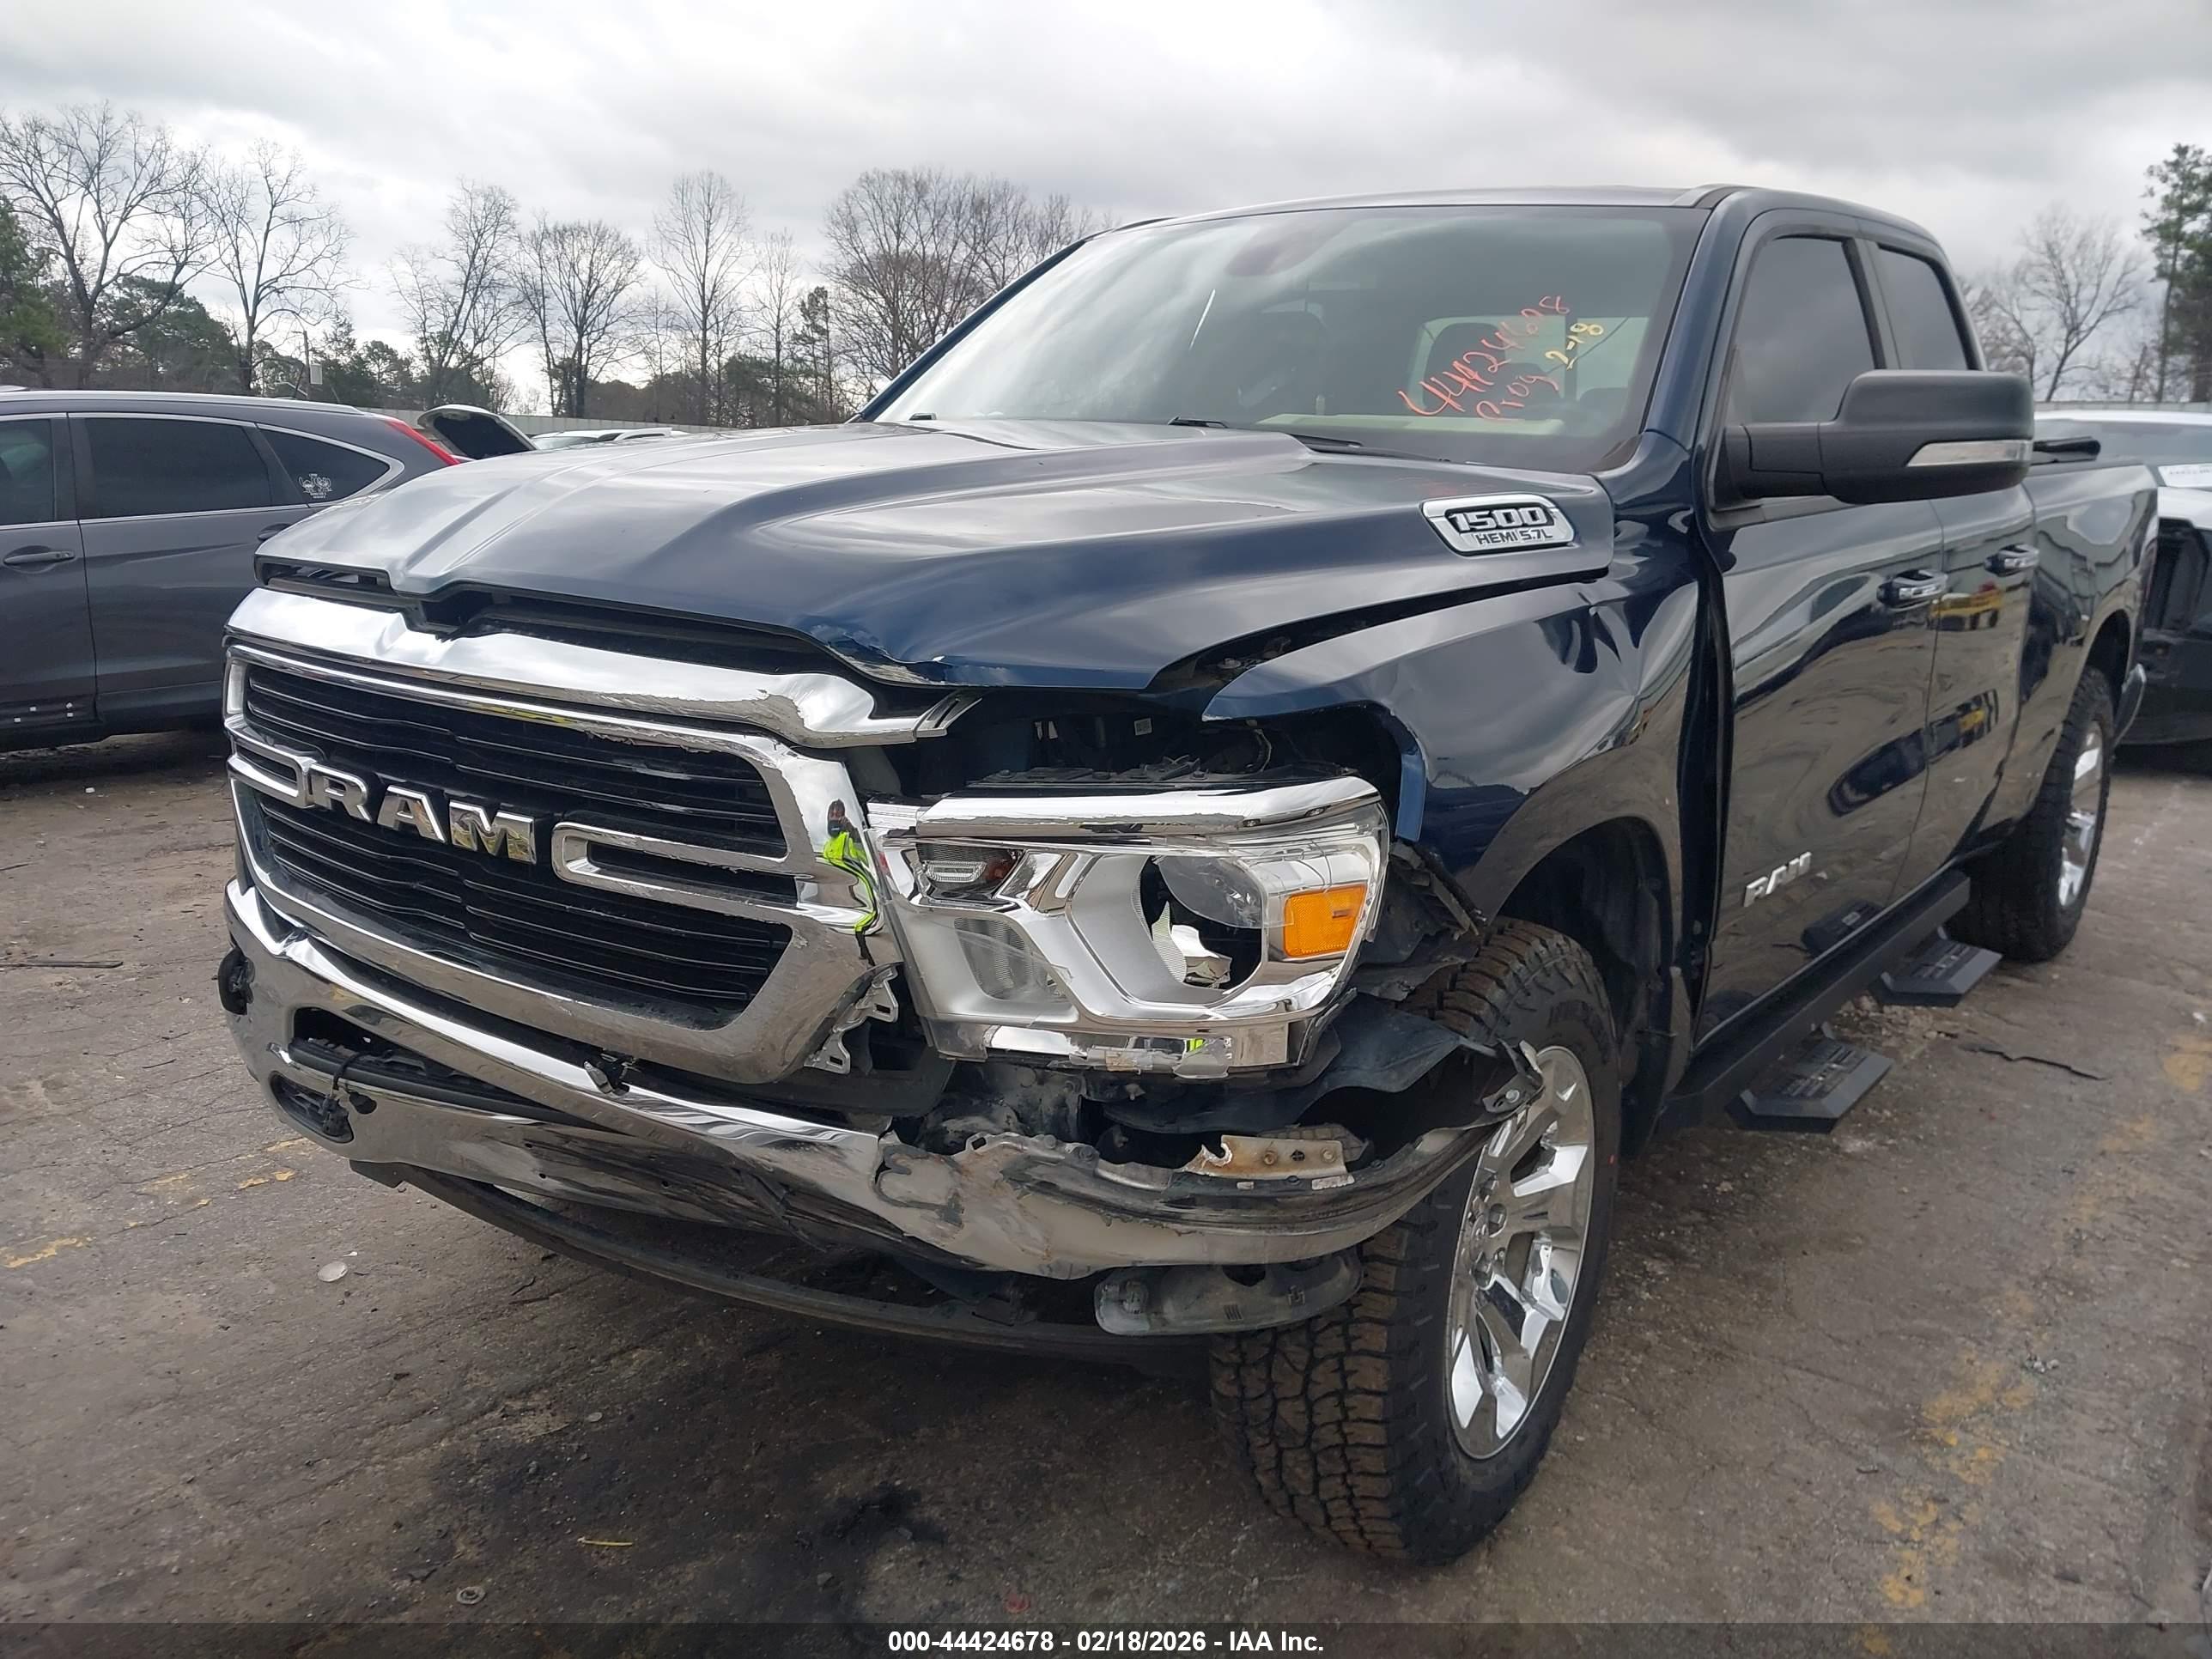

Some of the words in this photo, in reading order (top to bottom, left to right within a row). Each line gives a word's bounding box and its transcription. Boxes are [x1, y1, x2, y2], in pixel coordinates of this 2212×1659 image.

[1449, 507, 1548, 531] 1500
[1475, 532, 1518, 544] HEMI
[1519, 529, 1553, 541] 5.7L
[308, 763, 537, 866] RAM
[1743, 851, 1812, 907] RAM
